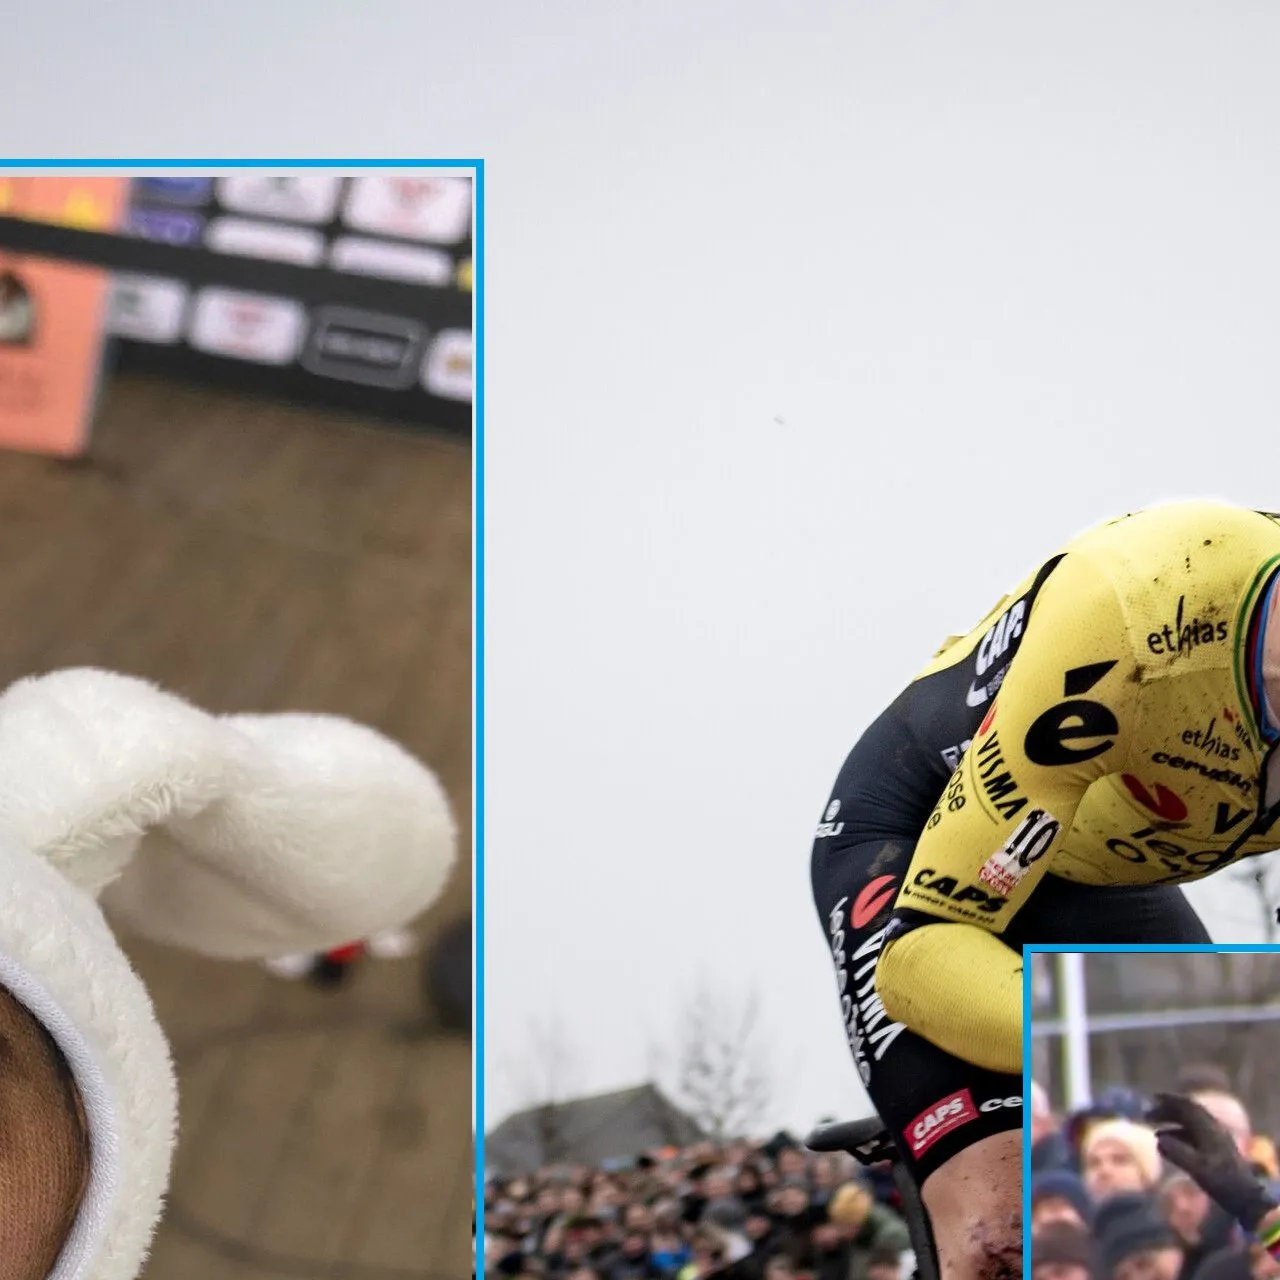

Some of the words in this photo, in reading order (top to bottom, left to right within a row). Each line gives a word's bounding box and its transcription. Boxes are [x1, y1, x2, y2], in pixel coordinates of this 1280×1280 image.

[1147, 594, 1228, 659] ethias
[1181, 717, 1240, 761] ethias
[977, 730, 1028, 821] VISMA
[1005, 809, 1060, 868] 10
[913, 868, 1009, 912] CAPS
[913, 1097, 965, 1140] CAPS
